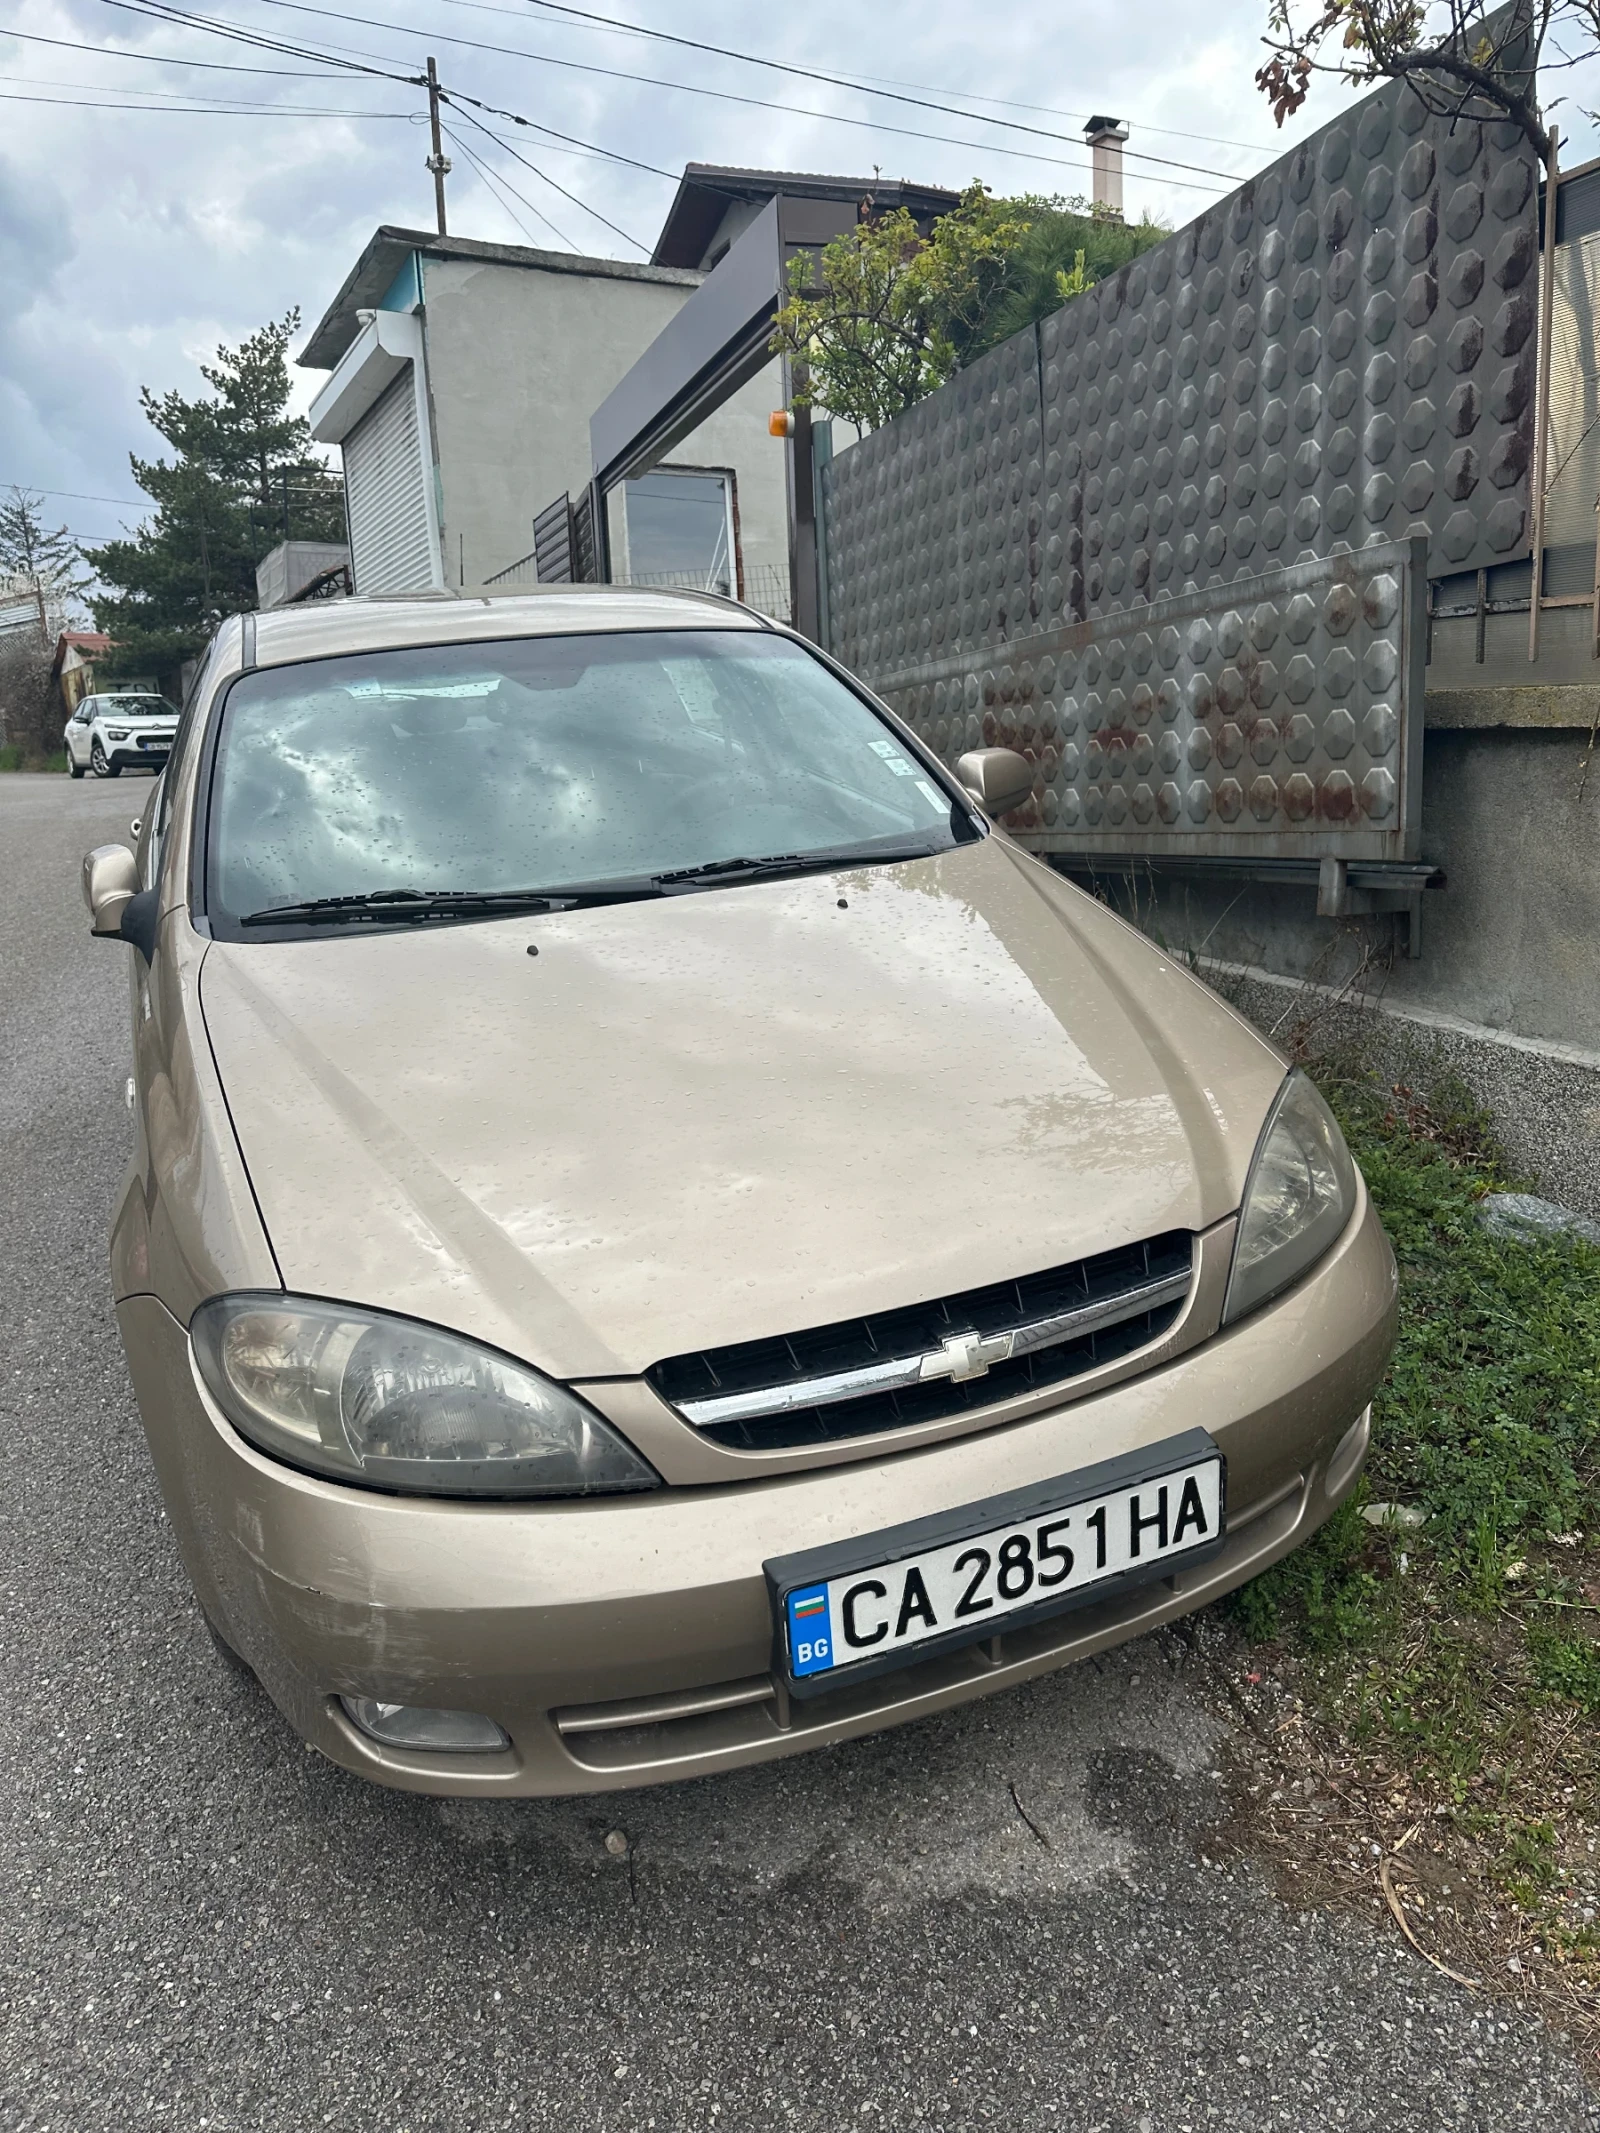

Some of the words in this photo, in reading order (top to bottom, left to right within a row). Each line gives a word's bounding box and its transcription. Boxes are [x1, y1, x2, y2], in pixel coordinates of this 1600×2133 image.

[842, 1567, 938, 1648] CA
[953, 1507, 1106, 1618] 2851
[1129, 1476, 1208, 1558] HA
[798, 1638, 828, 1663] BG
